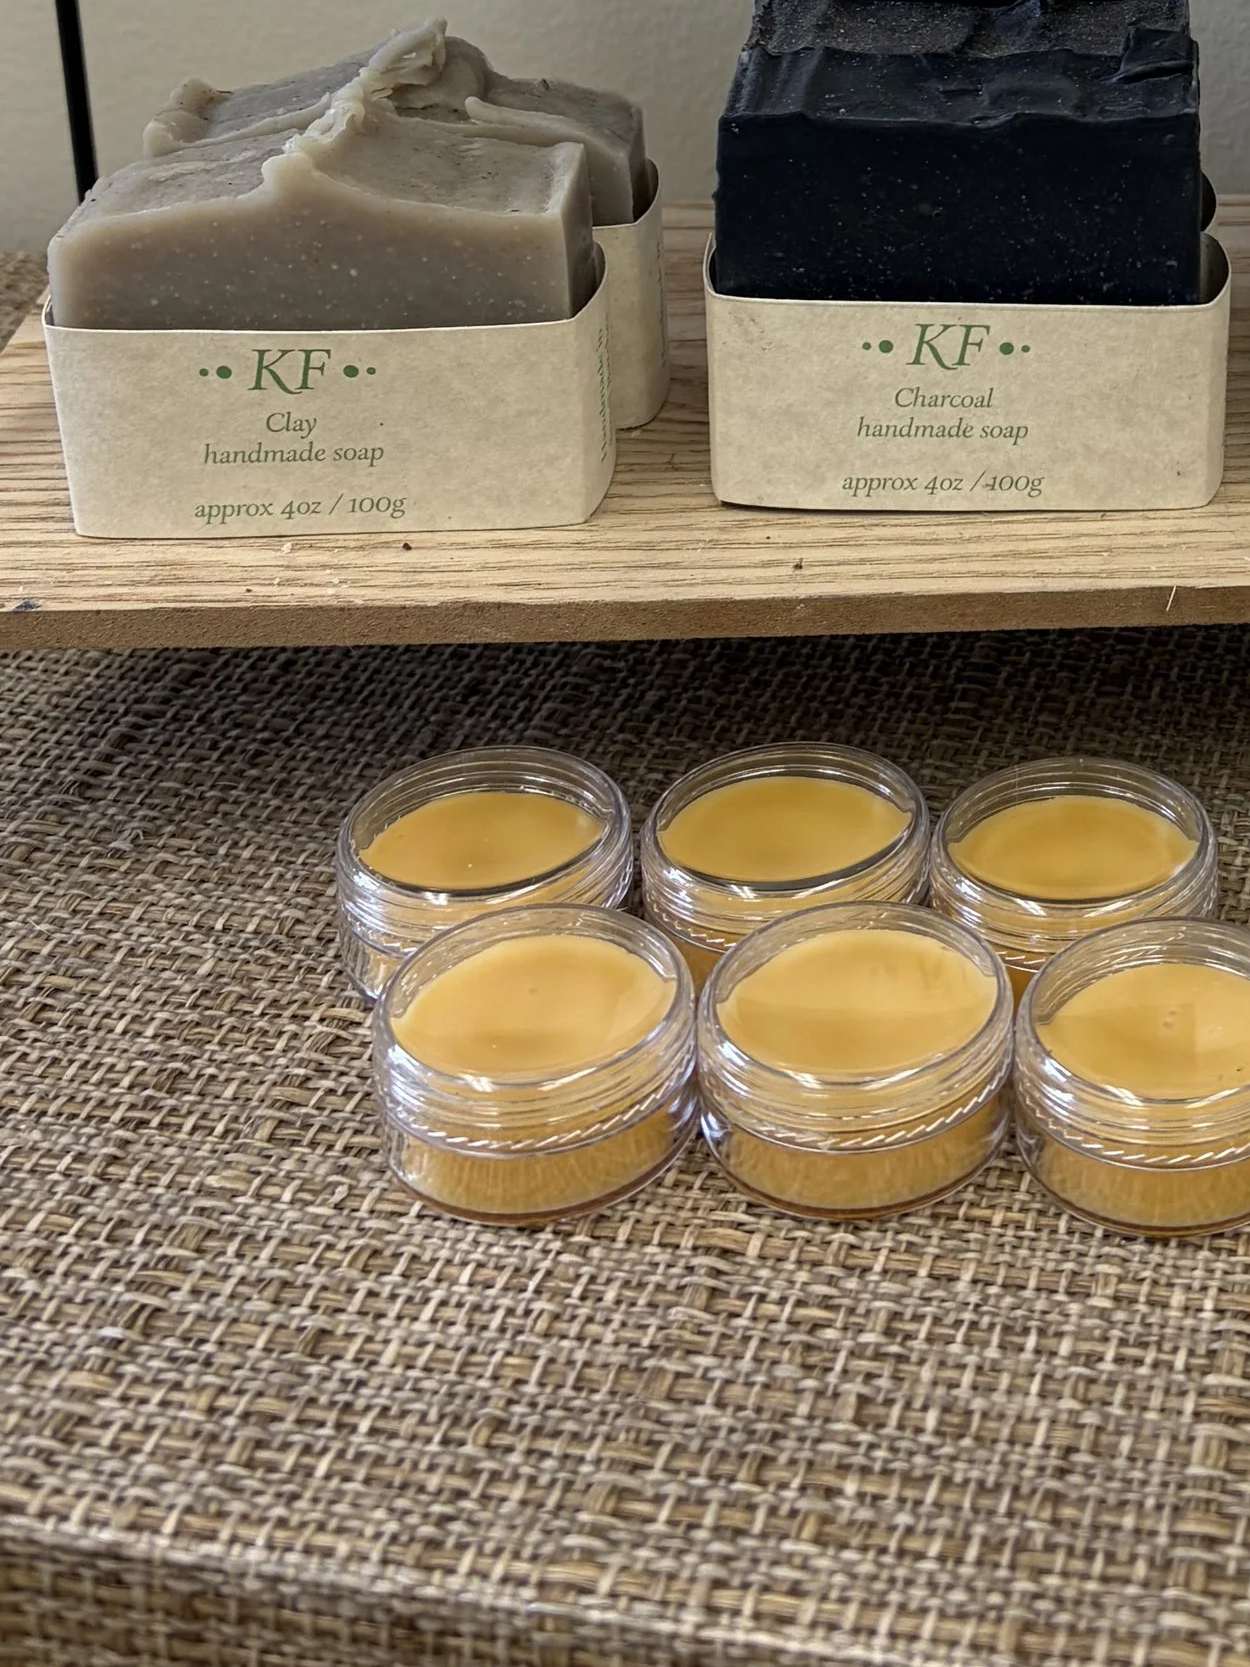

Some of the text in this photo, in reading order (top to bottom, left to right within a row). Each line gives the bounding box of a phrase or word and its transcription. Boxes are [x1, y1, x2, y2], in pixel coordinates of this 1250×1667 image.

[905, 323, 991, 370] KF
[247, 349, 331, 395] KF
[894, 387, 994, 408] Charcoal
[266, 412, 317, 438] Clay
[857, 417, 1028, 445] handmade soap
[204, 442, 384, 467] handmade soap
[842, 477, 917, 497] approx
[924, 476, 963, 495] 4oz
[987, 475, 1044, 498] 100g
[194, 501, 274, 524] approx
[281, 499, 322, 520] 4oz
[349, 496, 406, 519] 100g
